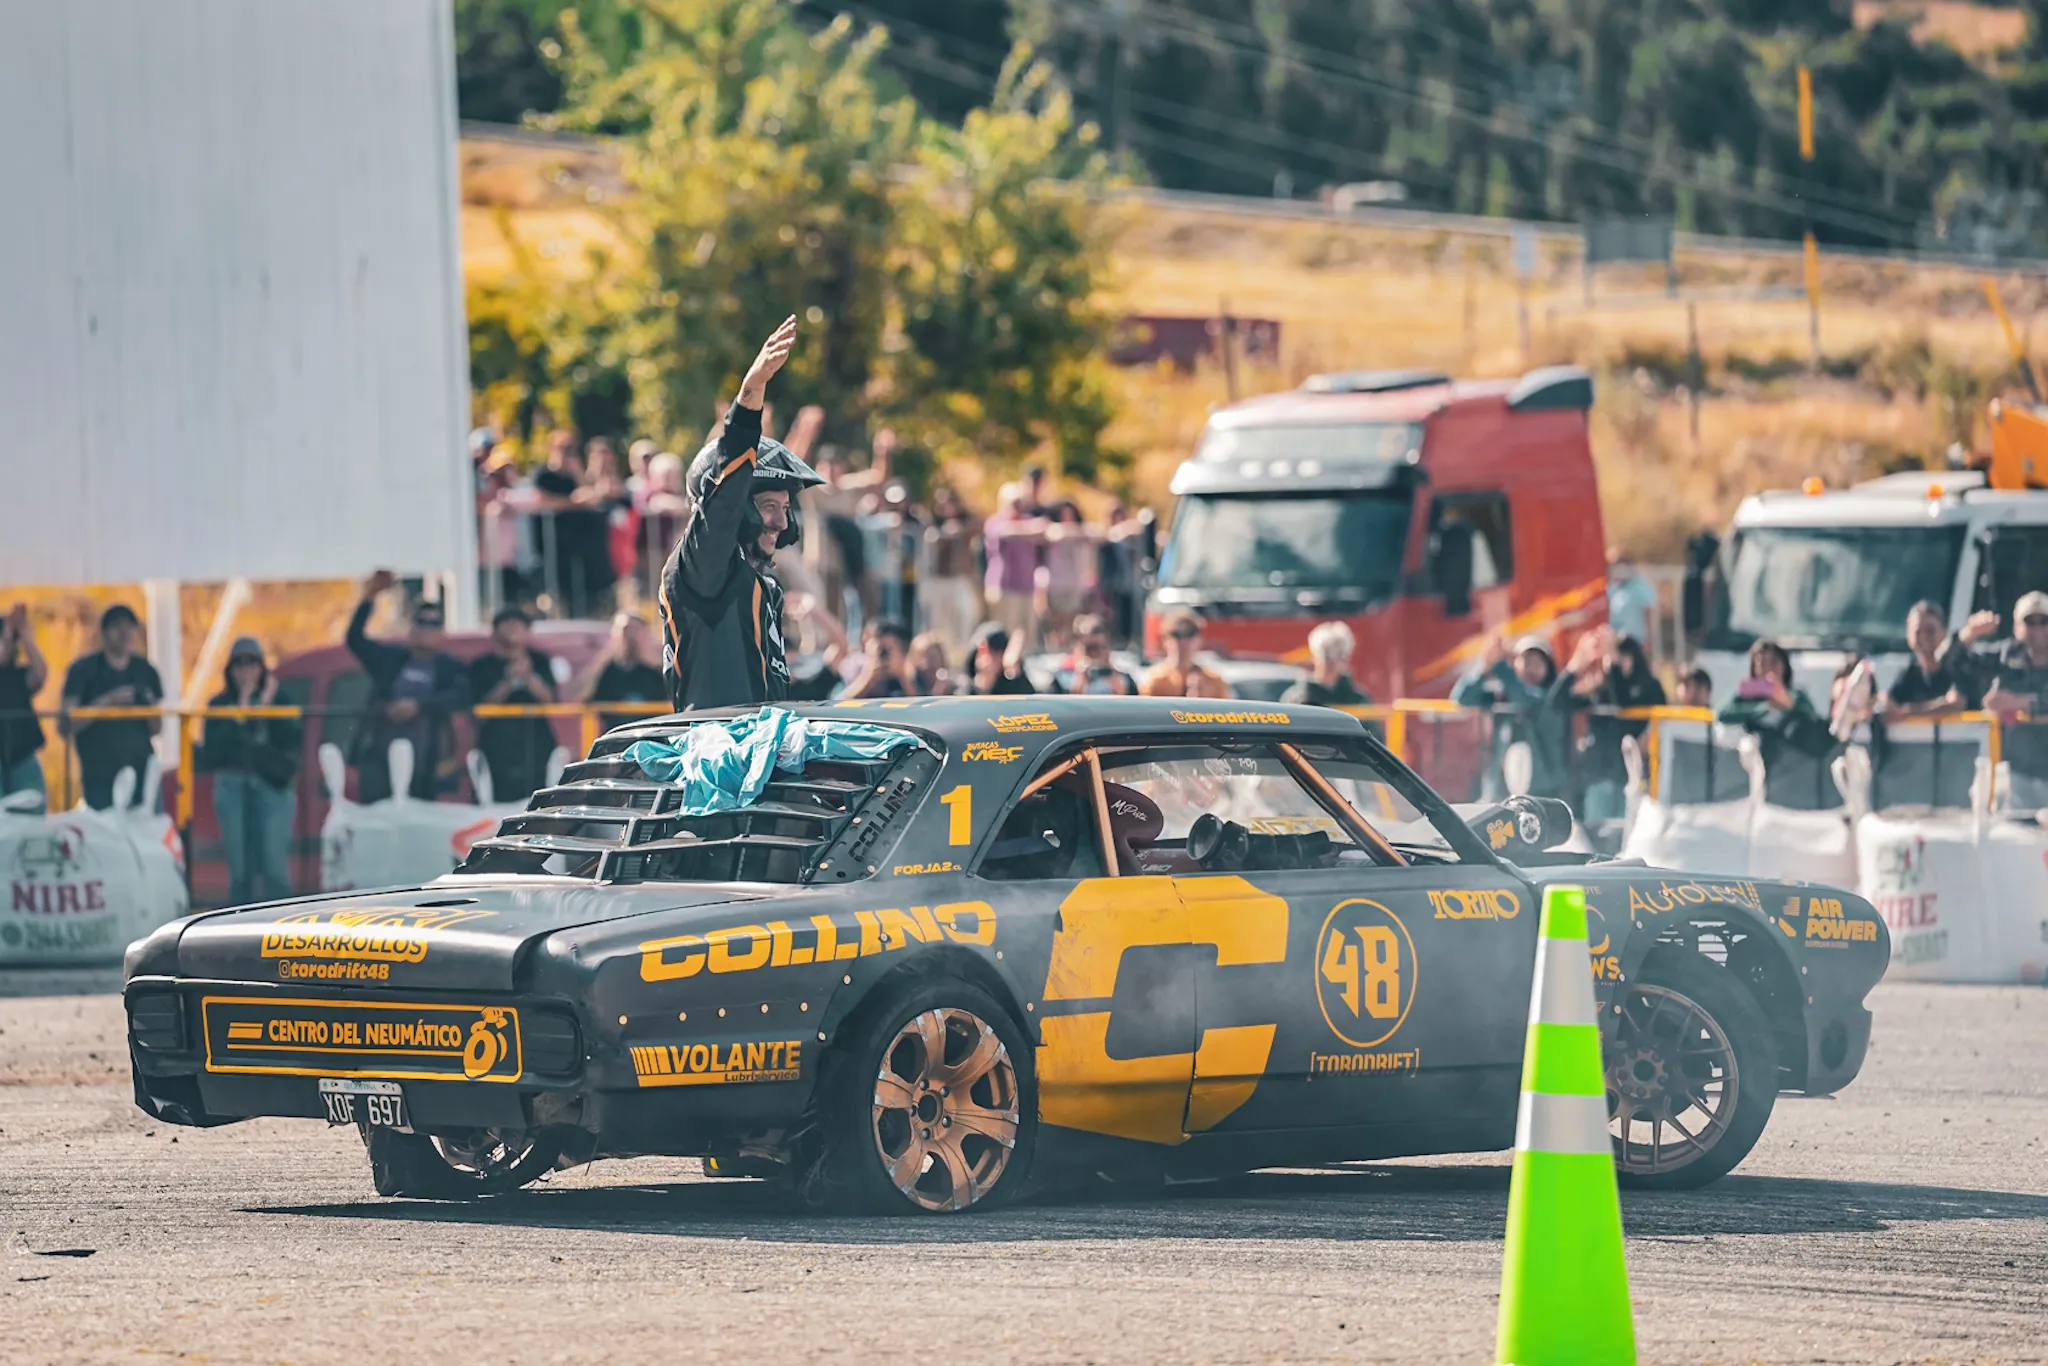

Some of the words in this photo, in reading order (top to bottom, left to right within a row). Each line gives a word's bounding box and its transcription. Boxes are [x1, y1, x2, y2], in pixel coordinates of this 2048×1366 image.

[940, 784, 972, 846] 1
[1426, 889, 1521, 922] TORINO
[1807, 897, 1845, 918] AIR
[265, 931, 423, 956] DESARROLLOS
[639, 900, 997, 983] COLLINO
[1806, 918, 1877, 942] POWER
[1320, 925, 1399, 1019] 48
[267, 1018, 329, 1045] CENTRO
[331, 1022, 362, 1046] DEL
[365, 1018, 463, 1048] NEUMÁTICO
[668, 1040, 802, 1074] VOLANTE
[723, 1068, 799, 1083] Lubriservice
[323, 1093, 355, 1123] XOF
[366, 1095, 402, 1126] 697
